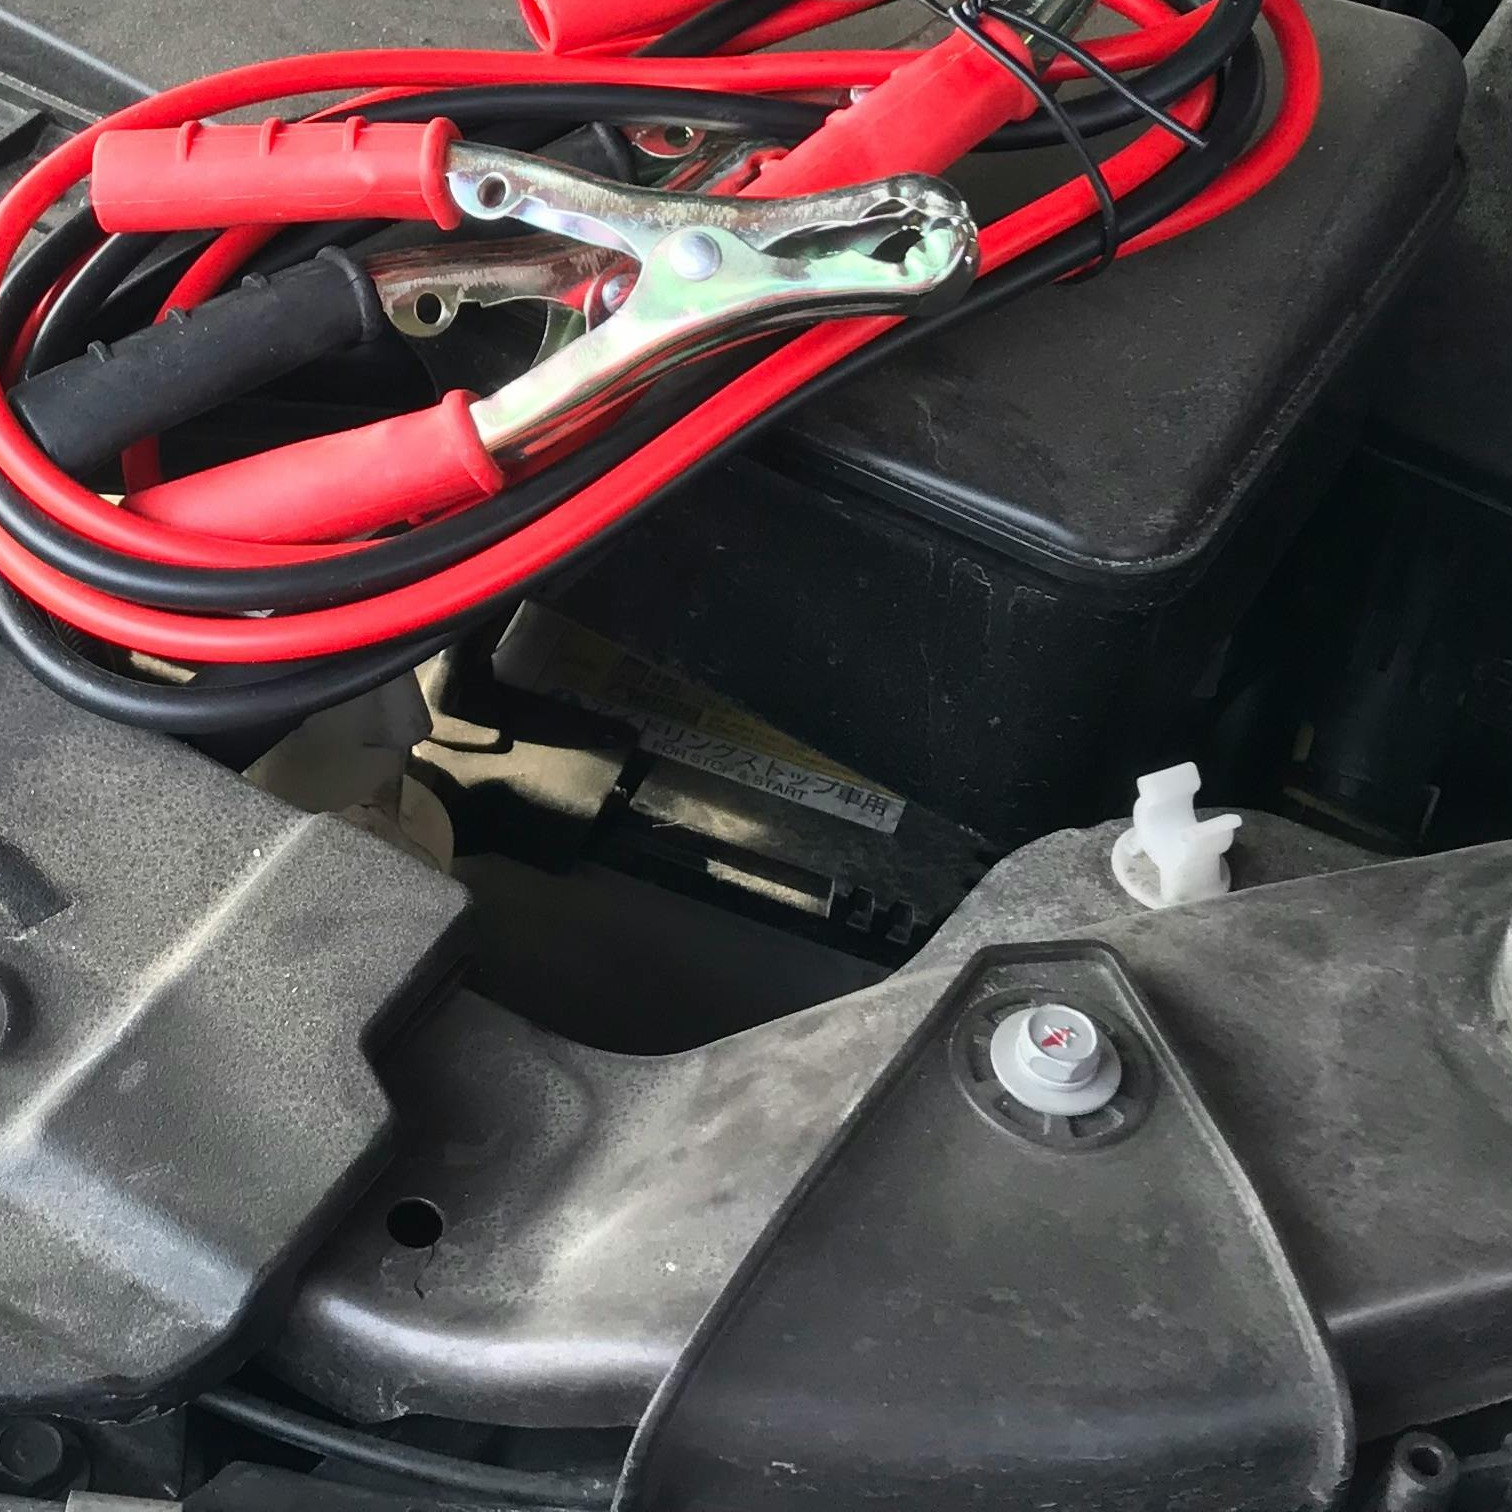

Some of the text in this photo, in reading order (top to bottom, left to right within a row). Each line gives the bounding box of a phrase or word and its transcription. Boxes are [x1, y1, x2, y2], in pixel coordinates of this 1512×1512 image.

[652, 741, 685, 759] FOR
[690, 752, 734, 774] STOP
[754, 774, 808, 801] START
